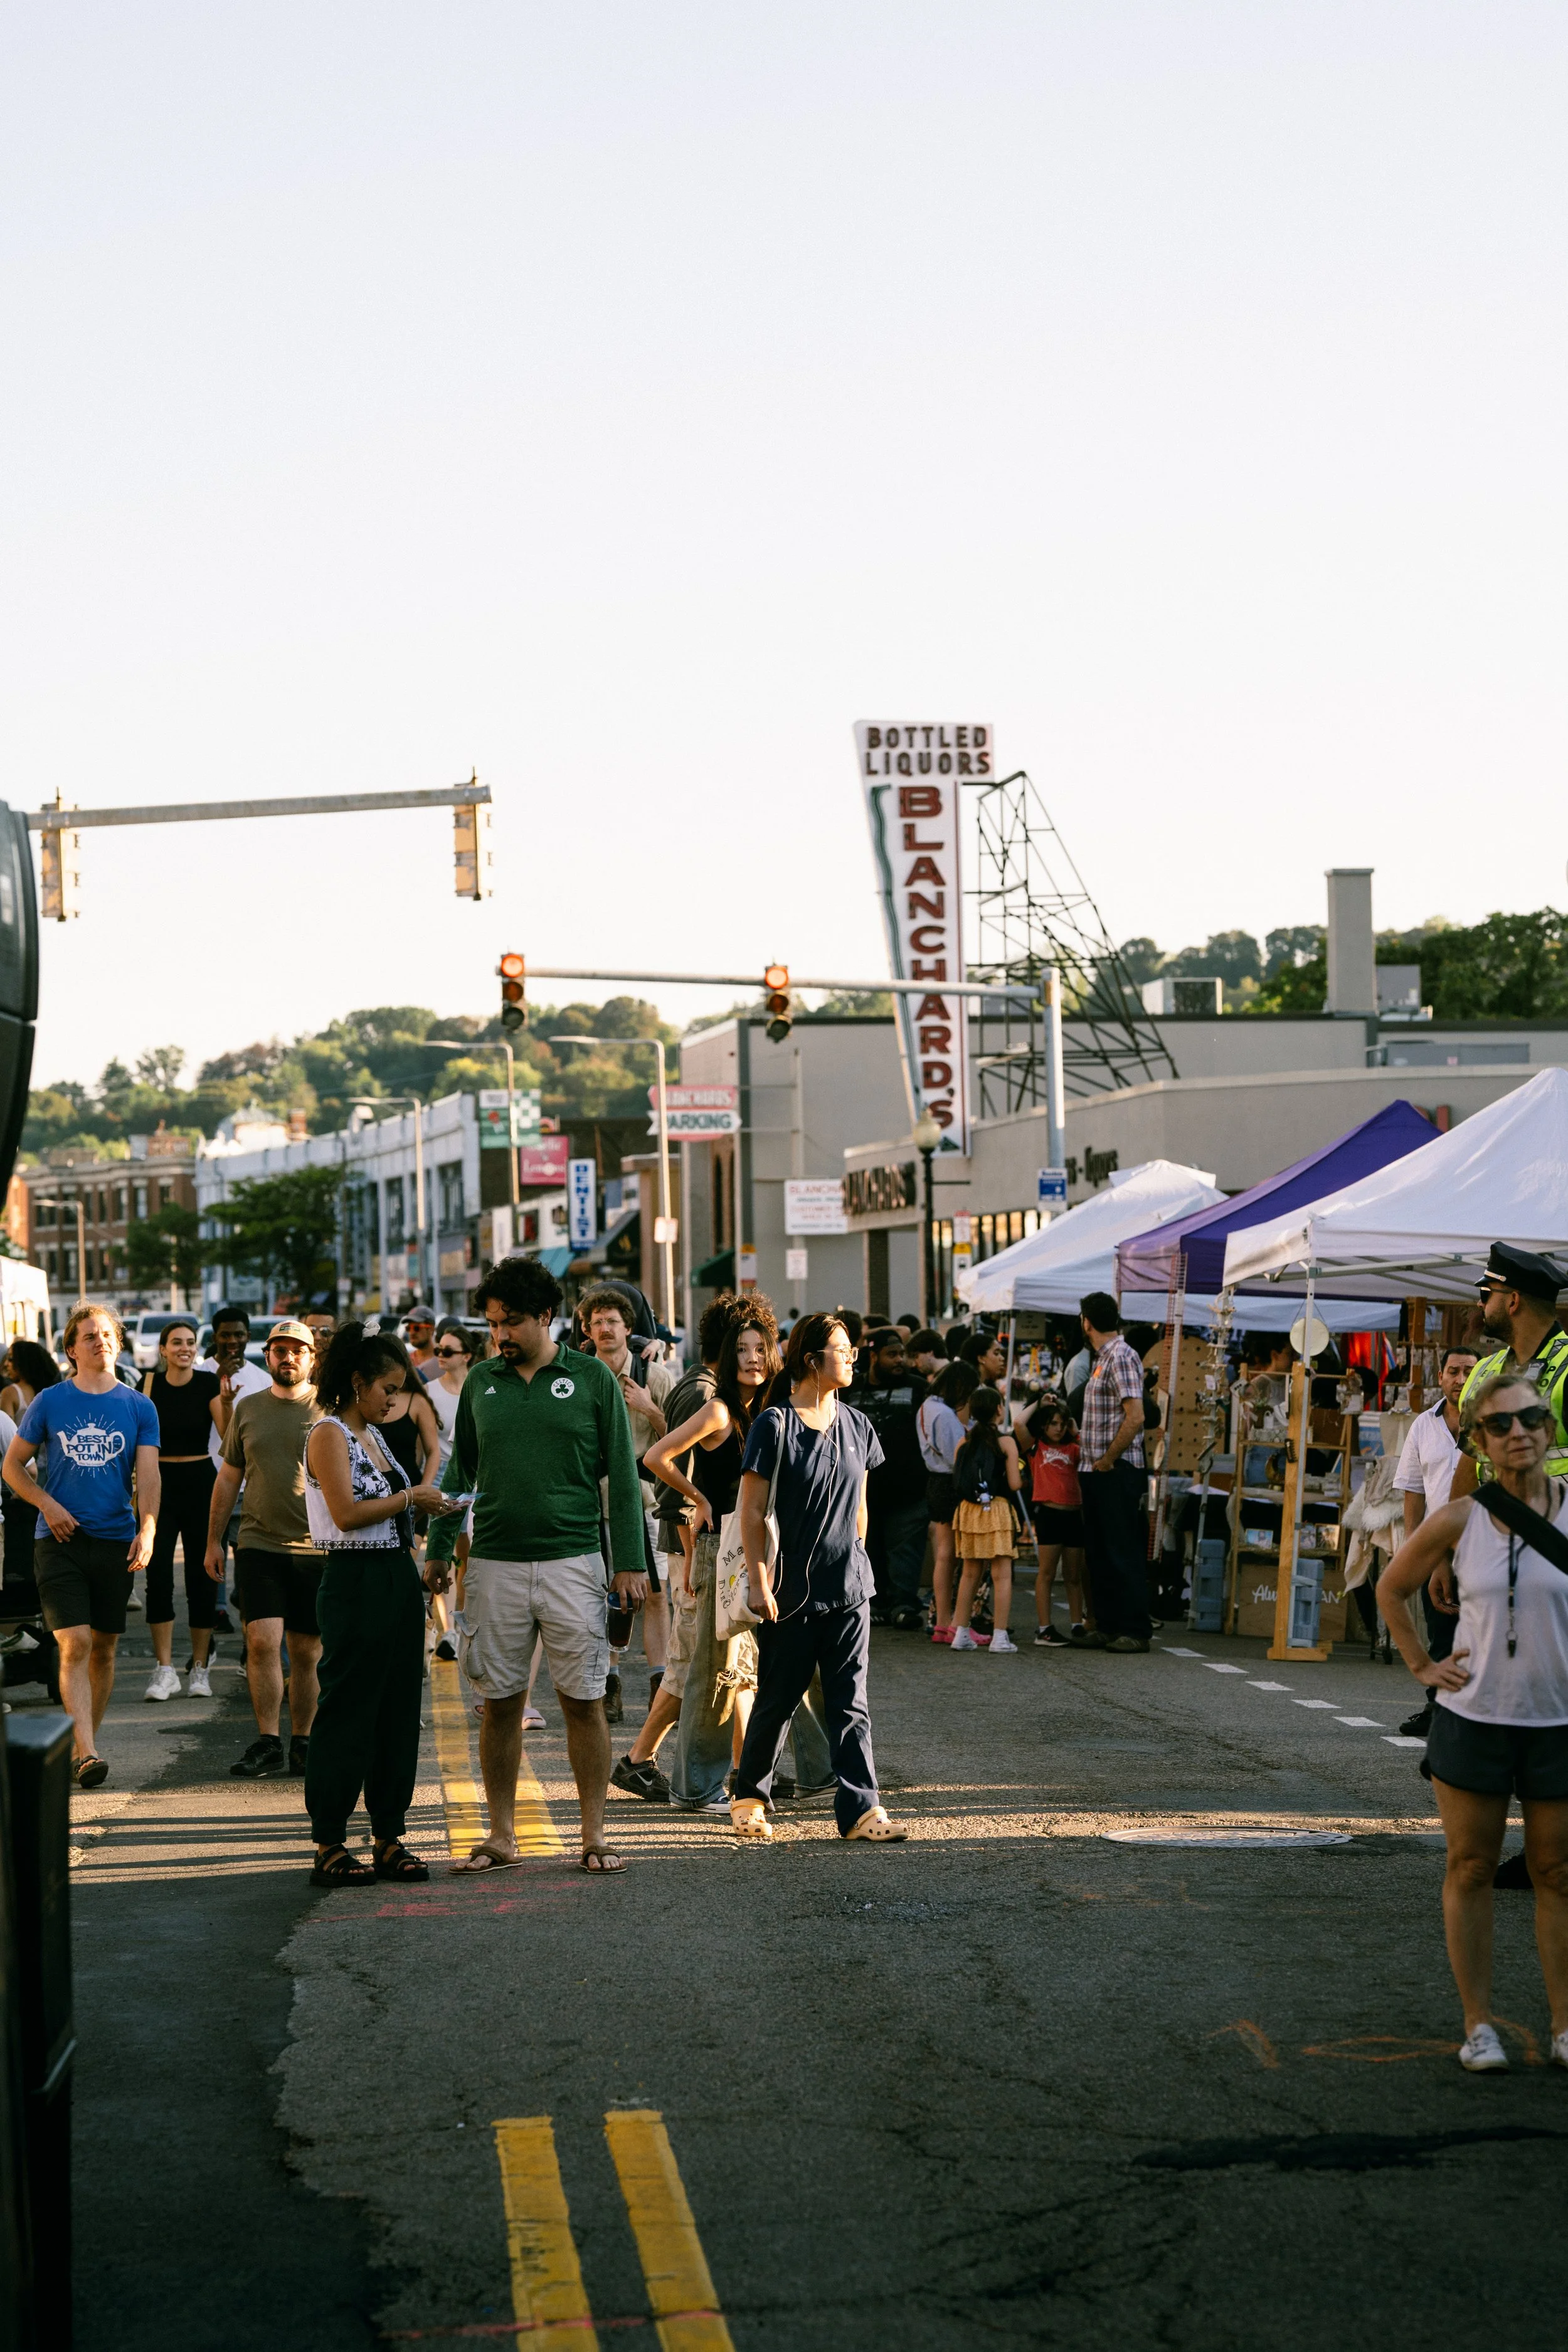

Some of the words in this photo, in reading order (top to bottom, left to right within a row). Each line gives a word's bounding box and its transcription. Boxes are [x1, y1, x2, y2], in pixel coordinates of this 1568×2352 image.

[867, 725, 987, 749] BOTTLED
[866, 751, 990, 776] LIQUORS
[667, 1113, 731, 1129] ARKING
[575, 1165, 589, 1237] DENTIST
[553, 1379, 573, 1387] CELTICS
[66, 1443, 95, 1454] POT
[98, 1441, 112, 1454] IN
[75, 1451, 105, 1461] TOWN
[722, 1546, 745, 1567] Ma
